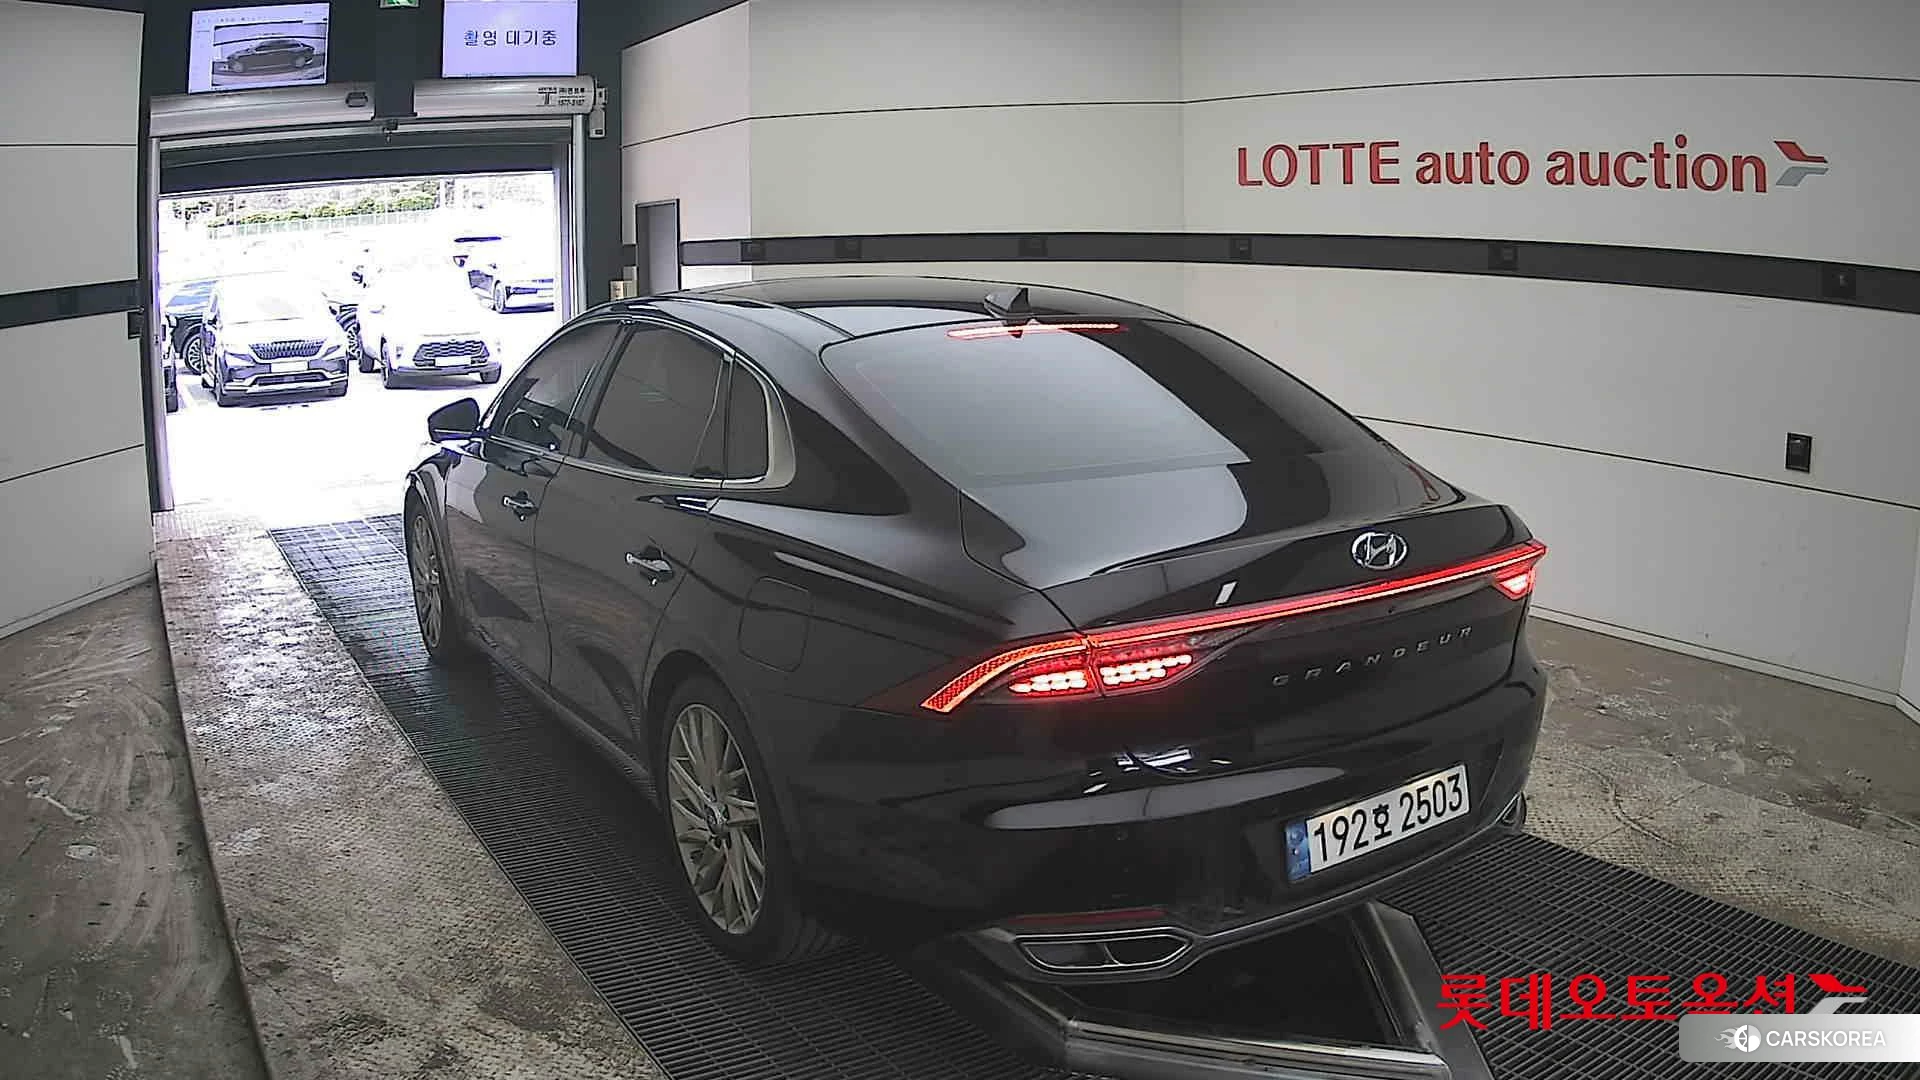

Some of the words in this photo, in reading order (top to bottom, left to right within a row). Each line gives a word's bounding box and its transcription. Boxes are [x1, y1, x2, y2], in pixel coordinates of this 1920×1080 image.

[505, 29, 557, 47] 대기중
[1237, 140, 1401, 187] LOTTE
[1415, 141, 1530, 186] auto
[1545, 133, 1769, 194] auction
[1272, 626, 1473, 687] GRANDEUR
[1314, 802, 1393, 863] 192호
[1399, 773, 1463, 832] 2503
